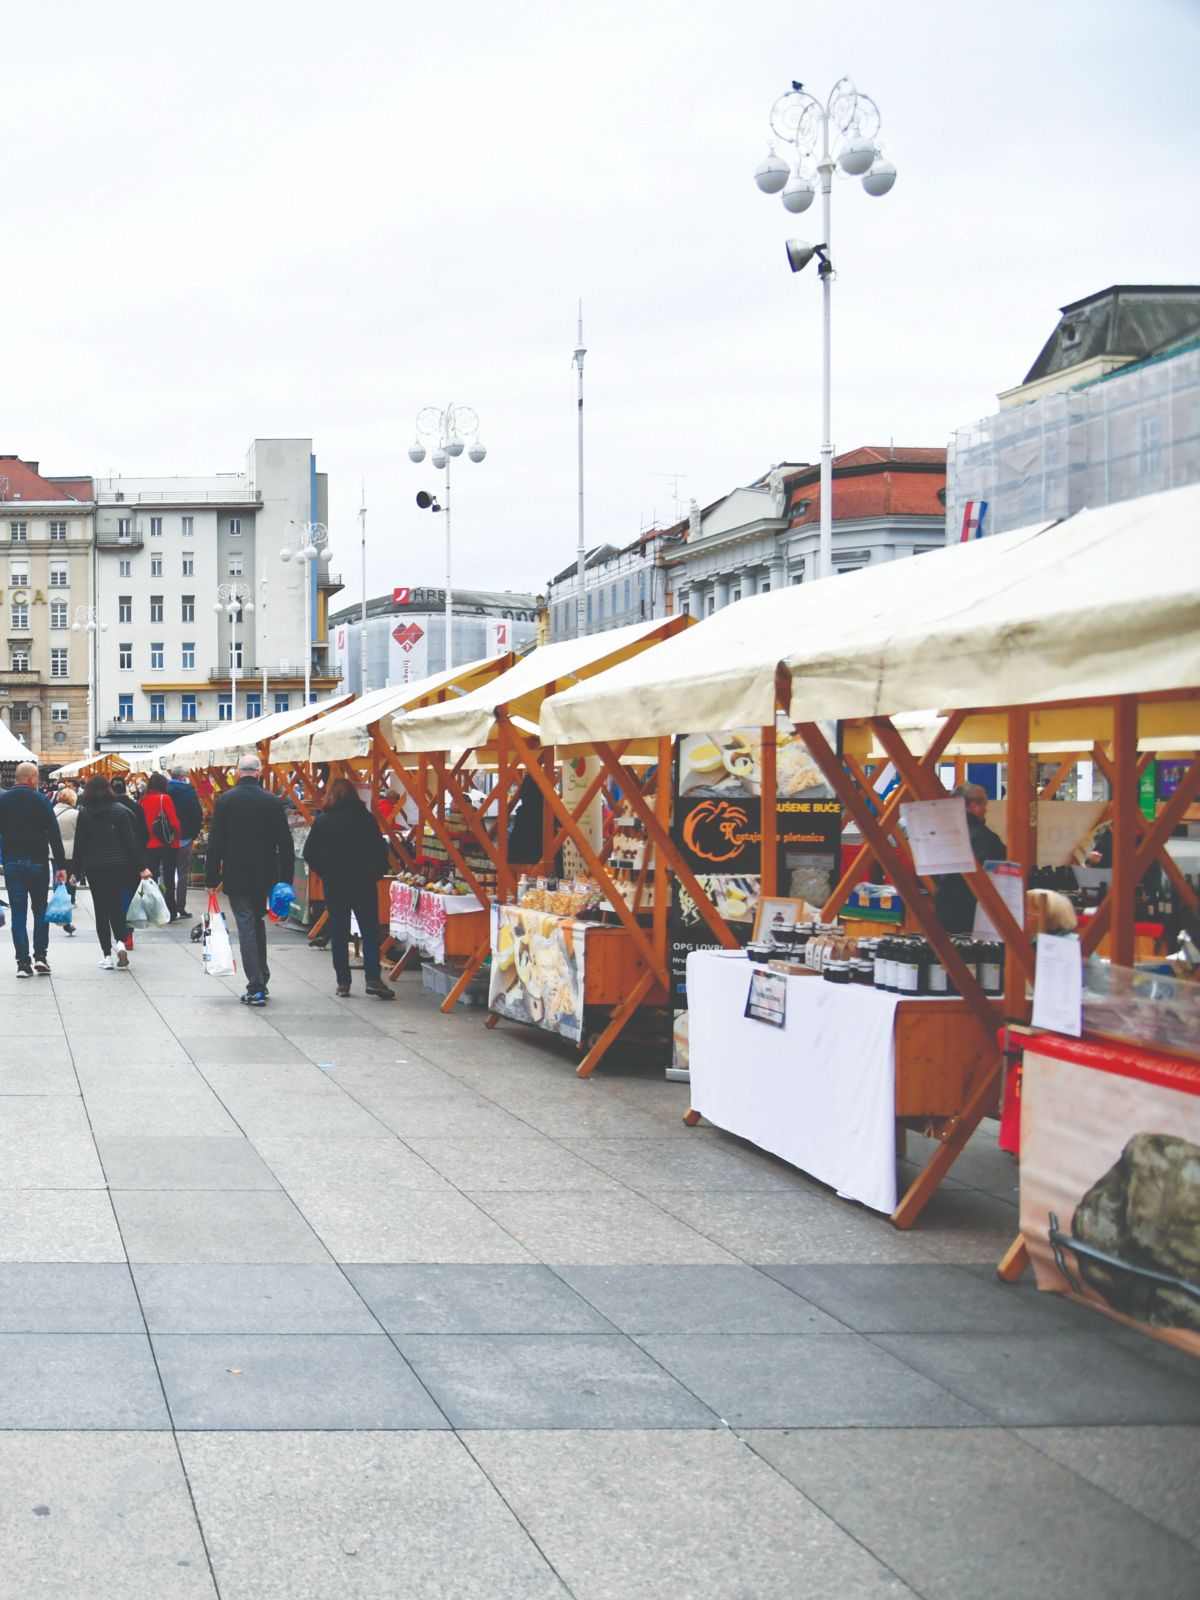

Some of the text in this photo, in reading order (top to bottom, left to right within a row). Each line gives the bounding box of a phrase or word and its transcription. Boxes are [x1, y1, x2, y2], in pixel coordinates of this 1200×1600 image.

[776, 801, 840, 813] UŠENE BUČE
[783, 832, 825, 844] pletenice
[672, 942, 693, 951] OPG
